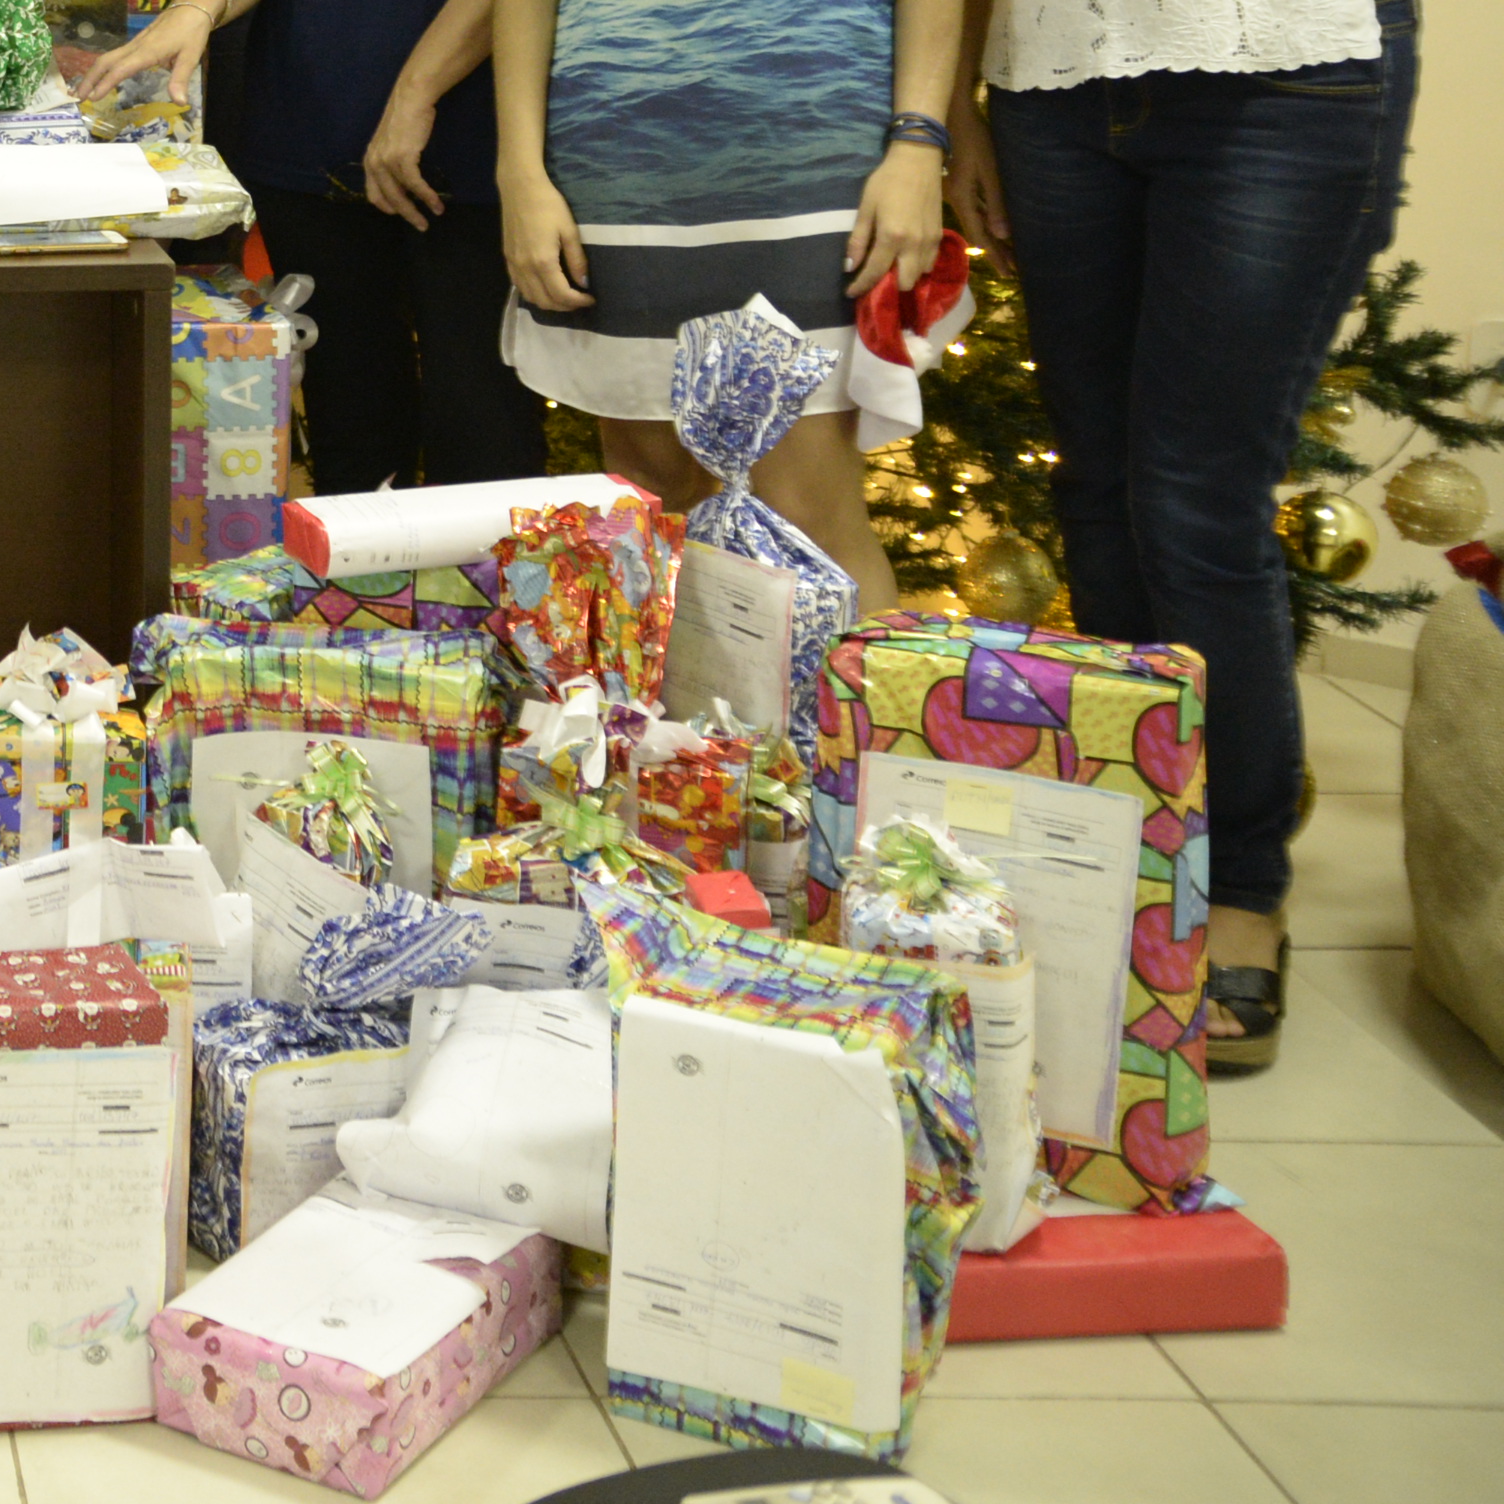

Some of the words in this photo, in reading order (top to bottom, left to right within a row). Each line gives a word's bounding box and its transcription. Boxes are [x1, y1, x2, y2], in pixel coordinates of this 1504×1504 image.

[220, 373, 262, 412] A
[220, 448, 262, 478] 8
[512, 922, 545, 932] Correios
